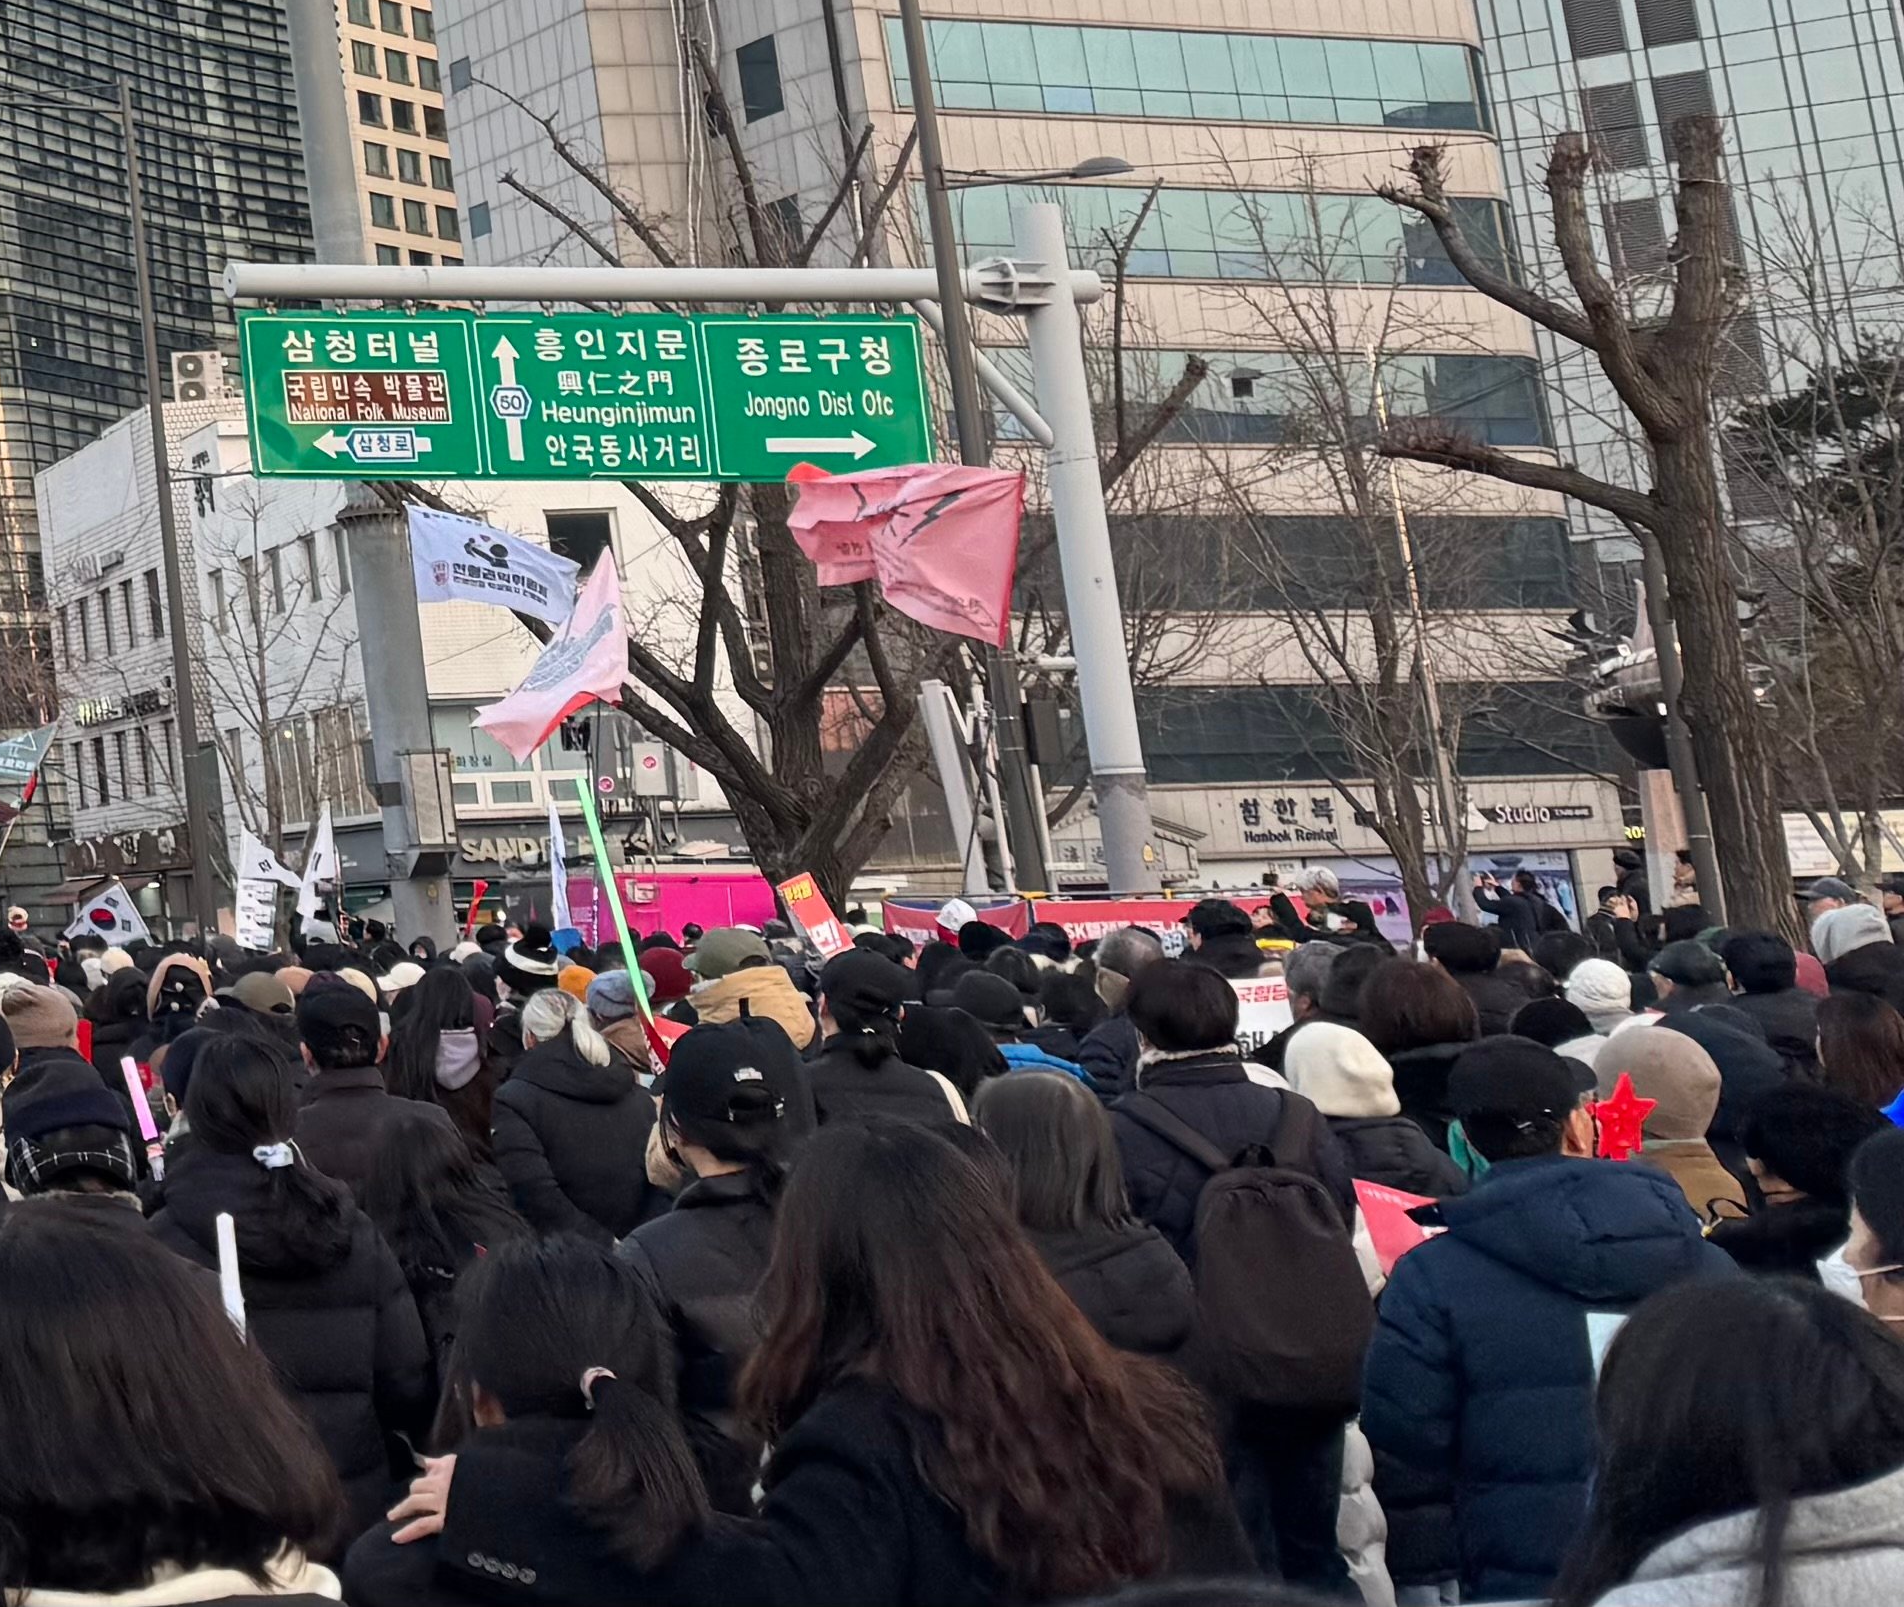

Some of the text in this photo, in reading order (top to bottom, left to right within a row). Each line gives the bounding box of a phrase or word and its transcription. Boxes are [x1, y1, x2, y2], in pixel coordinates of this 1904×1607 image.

[282, 329, 440, 364] 삼청터널
[534, 328, 687, 362] 흥인지문
[736, 336, 892, 377] 종로구청
[287, 374, 445, 402] 국립민속 박물관
[557, 370, 674, 396] 興仁之門
[291, 402, 447, 421] National Folk Museum
[500, 395, 522, 410] 50
[541, 400, 696, 428] Heunginjimun
[744, 389, 894, 421] Jongno Dist Ofc
[358, 434, 411, 453] 삼청로
[545, 434, 701, 468] 안국동사거리
[1494, 802, 1551, 824] Studio
[1243, 829, 1292, 844] Hanbok
